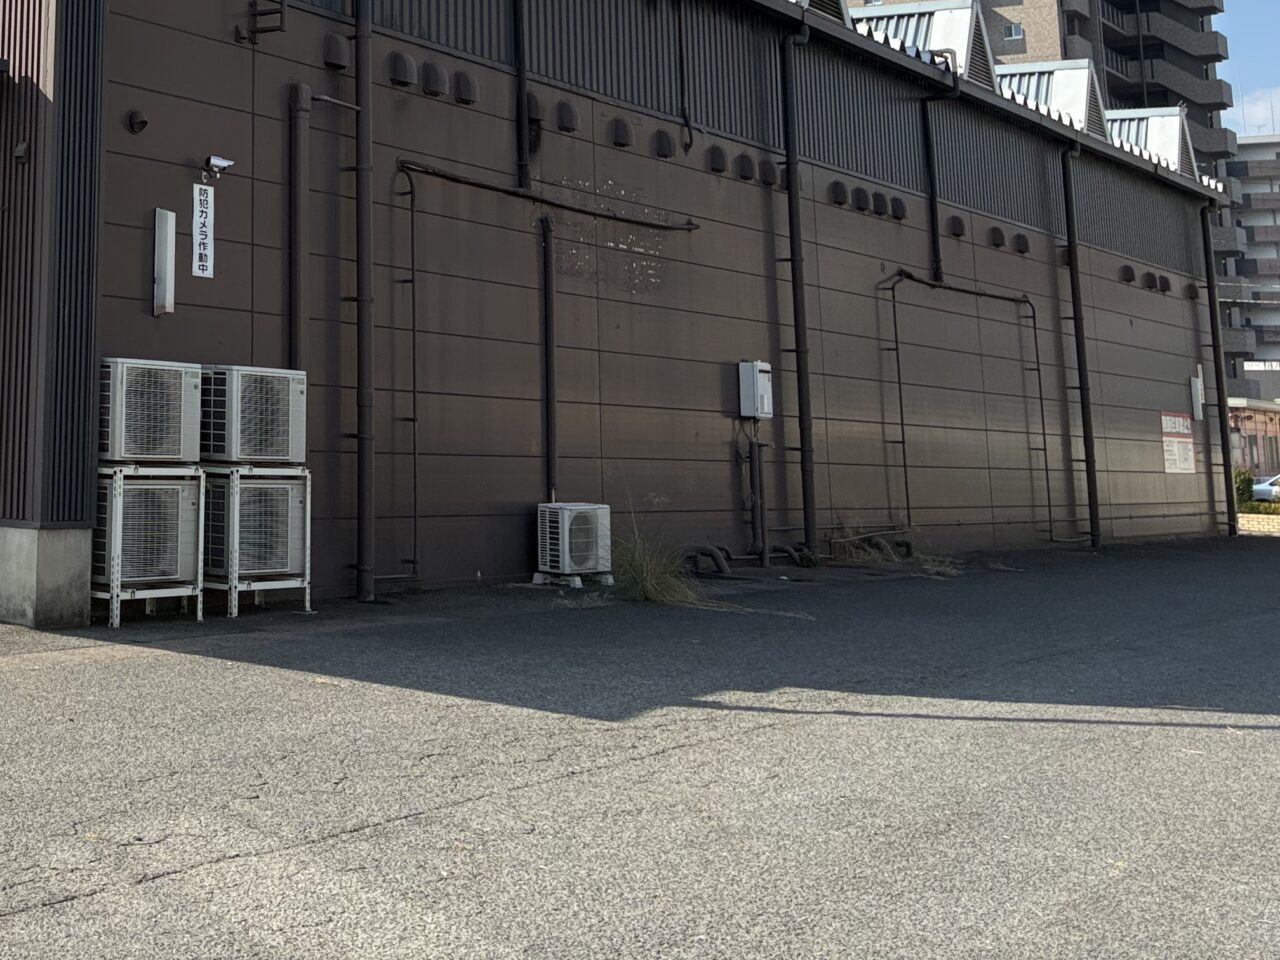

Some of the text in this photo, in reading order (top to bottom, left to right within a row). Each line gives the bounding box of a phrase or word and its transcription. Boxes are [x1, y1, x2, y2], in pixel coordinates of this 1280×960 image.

[198, 187, 209, 275] 防犯カメラ作動中
